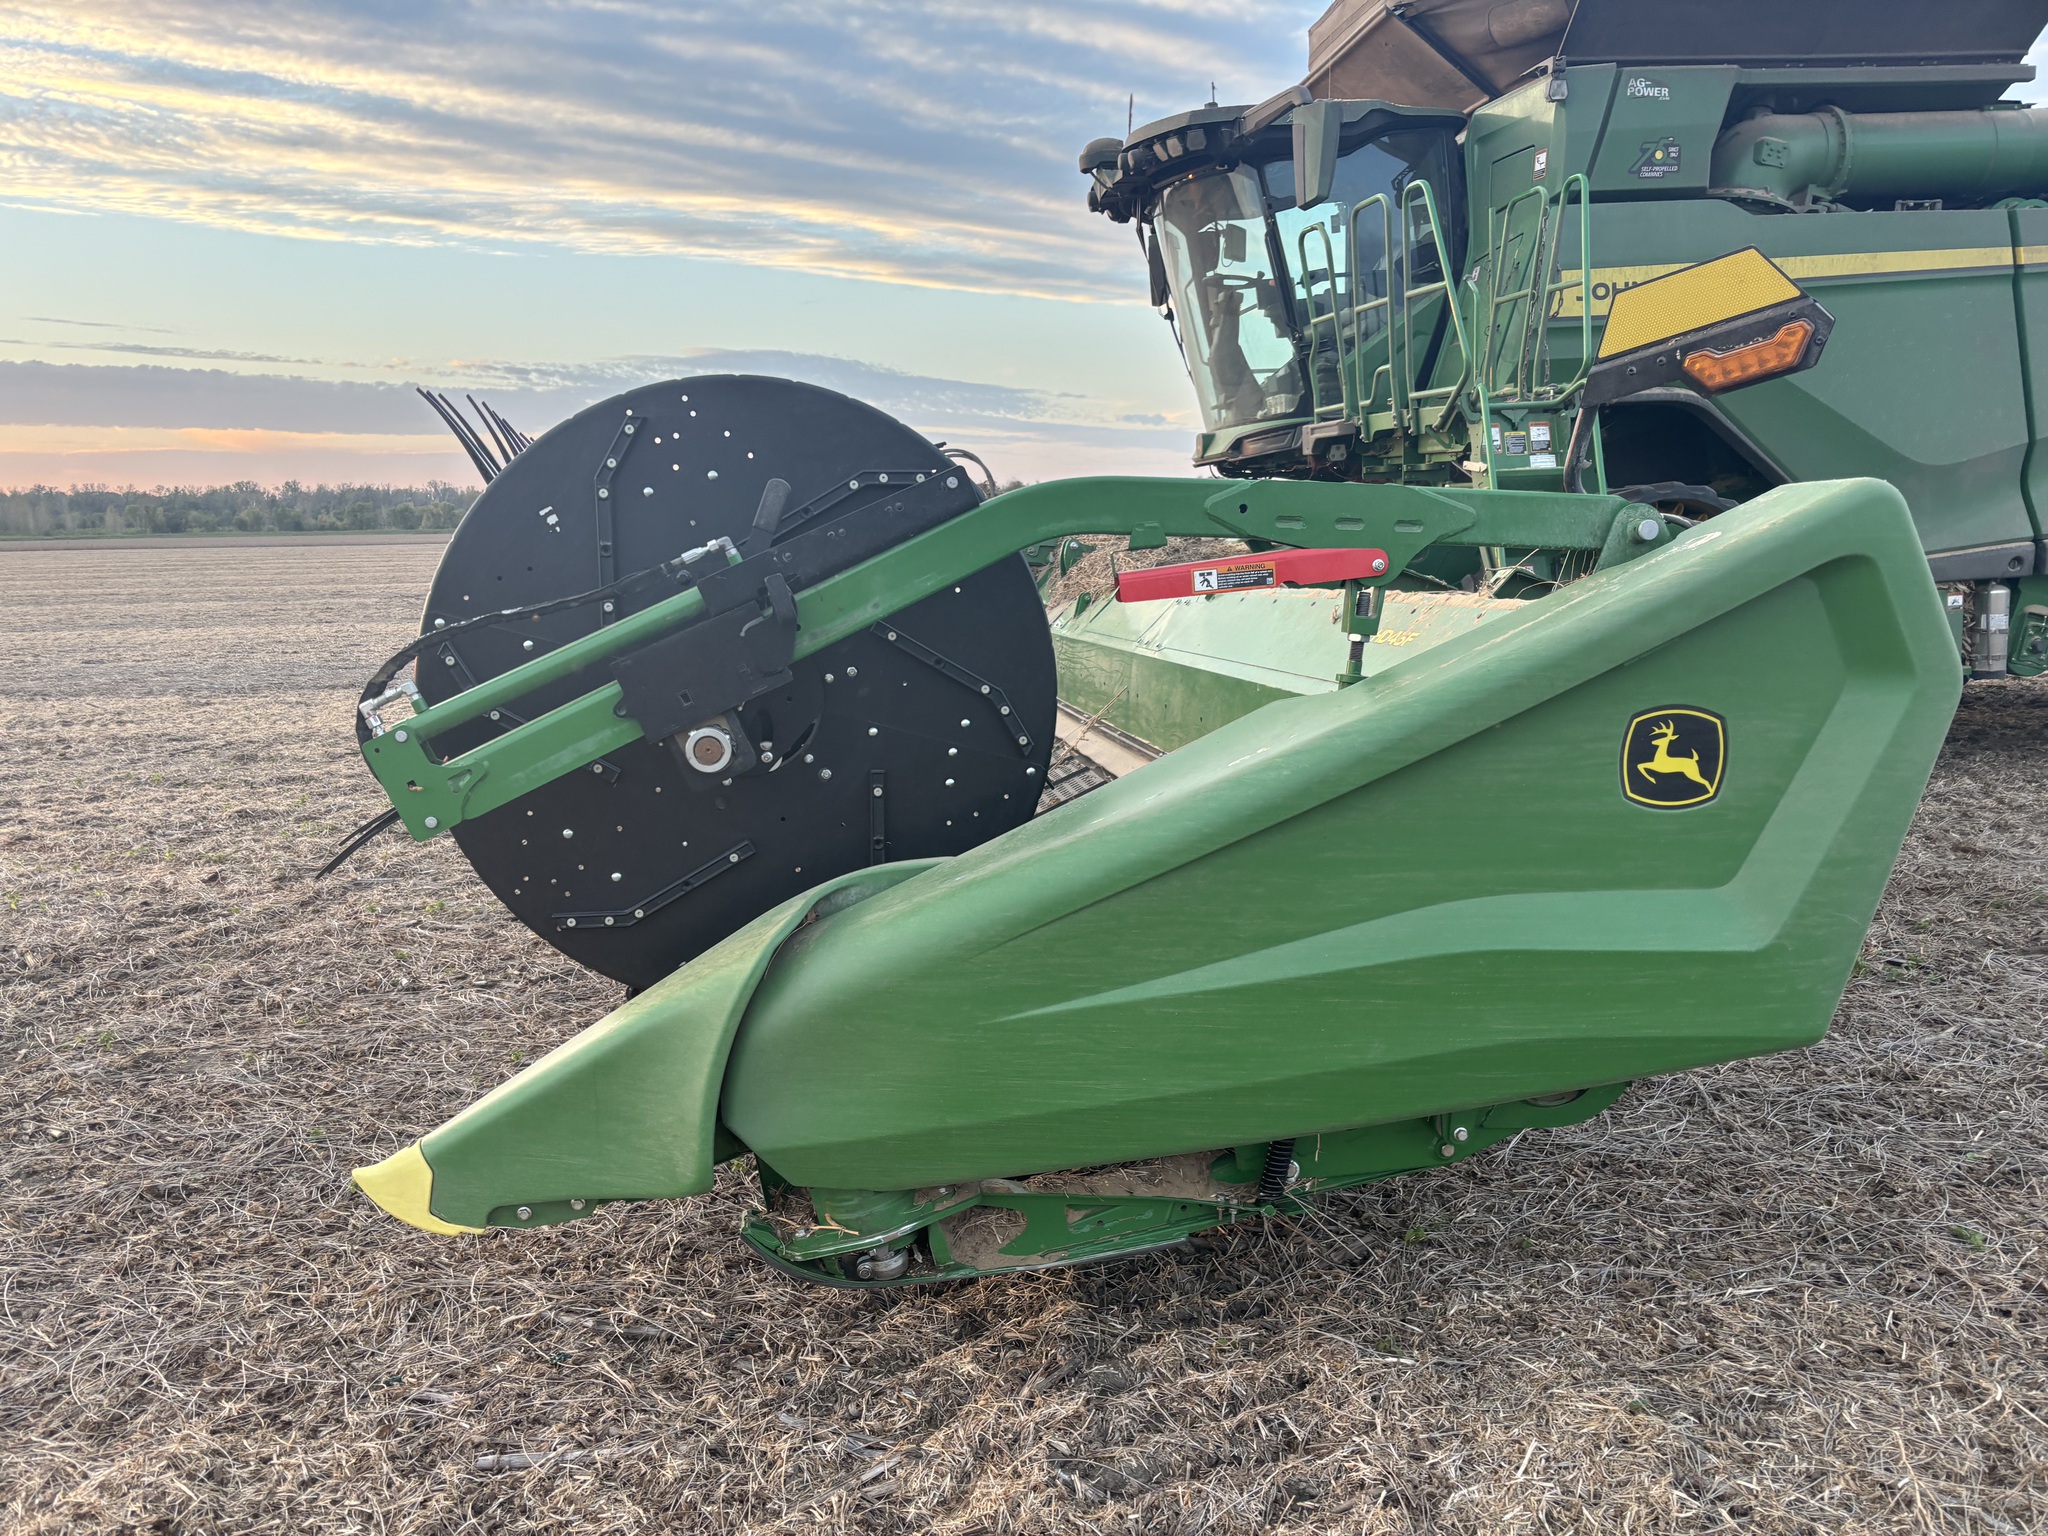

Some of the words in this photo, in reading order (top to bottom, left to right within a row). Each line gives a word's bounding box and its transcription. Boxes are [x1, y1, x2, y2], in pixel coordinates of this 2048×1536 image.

[1628, 78, 1652, 87] AG-
[1627, 87, 1669, 96] POWER
[1235, 563, 1266, 571] WARNING
